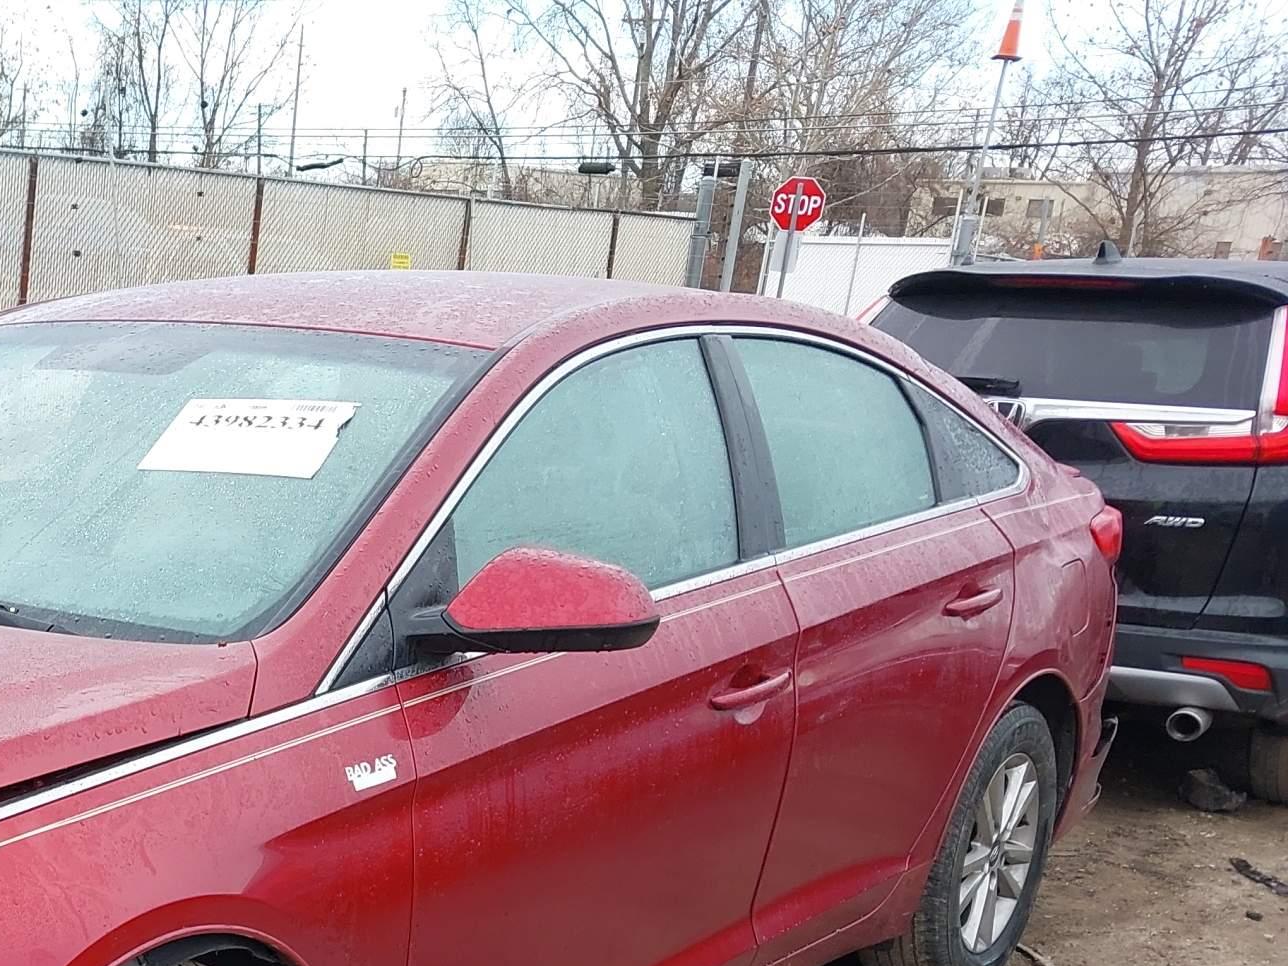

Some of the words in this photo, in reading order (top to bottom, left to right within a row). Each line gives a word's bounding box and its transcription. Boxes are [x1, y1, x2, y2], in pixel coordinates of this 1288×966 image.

[774, 193, 821, 216] STOP
[189, 414, 326, 431] 43982334
[1143, 515, 1205, 528] AWD
[344, 761, 372, 782] BAD
[374, 753, 397, 774] ASS
